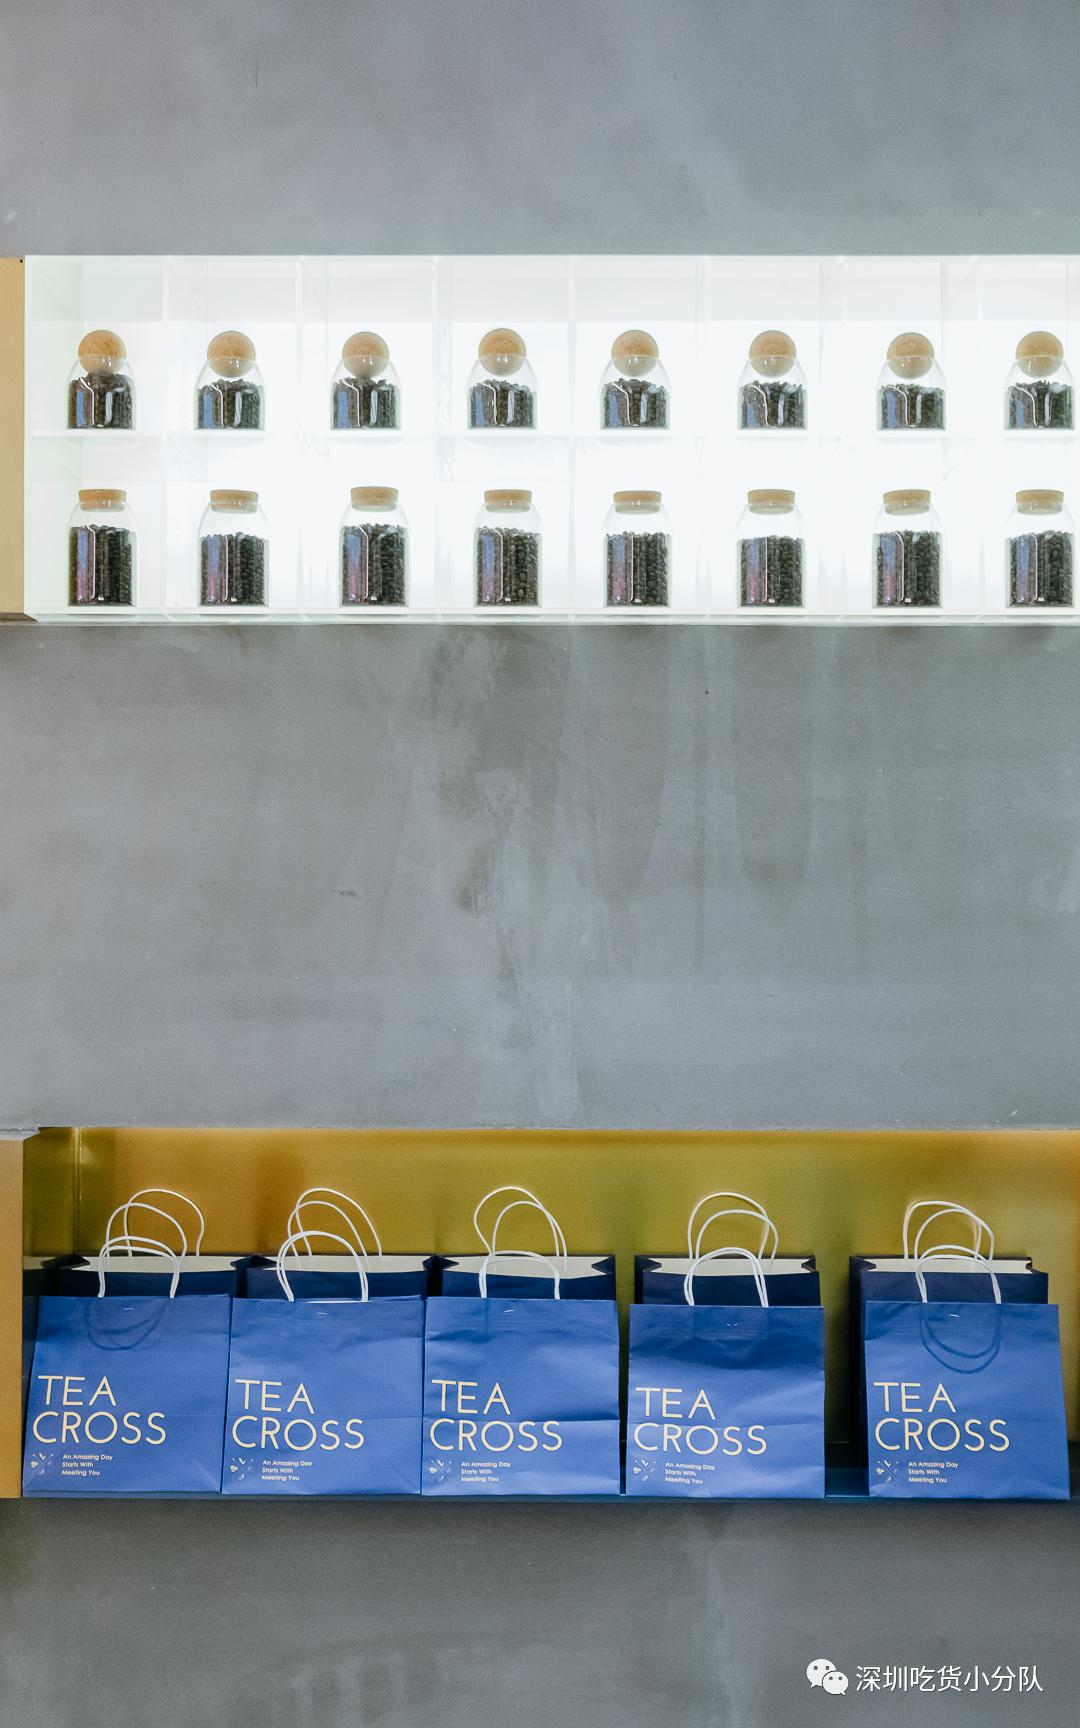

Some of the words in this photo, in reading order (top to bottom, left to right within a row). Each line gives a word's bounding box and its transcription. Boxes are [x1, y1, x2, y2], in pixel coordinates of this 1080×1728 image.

[38, 1376, 116, 1406] TEA
[235, 1379, 314, 1414] TEA
[432, 1380, 510, 1415] TEA
[636, 1387, 715, 1420] TEA
[873, 1382, 956, 1412] TEA
[33, 1411, 166, 1444] CROSS
[232, 1416, 364, 1450] CROSS
[430, 1419, 562, 1451] CROSS
[634, 1423, 766, 1455] CROSS
[875, 1418, 1009, 1451] CROSS
[61, 1469, 87, 1477] Meeting
[262, 1474, 287, 1482] Meeting
[301, 1460, 312, 1468] Day
[676, 1462, 701, 1470] Amazing
[919, 1461, 944, 1469] Amazing
[946, 1461, 959, 1469] Day
[665, 1476, 691, 1484] Meeting
[693, 1477, 703, 1485] You
[908, 1476, 934, 1484] Meeting
